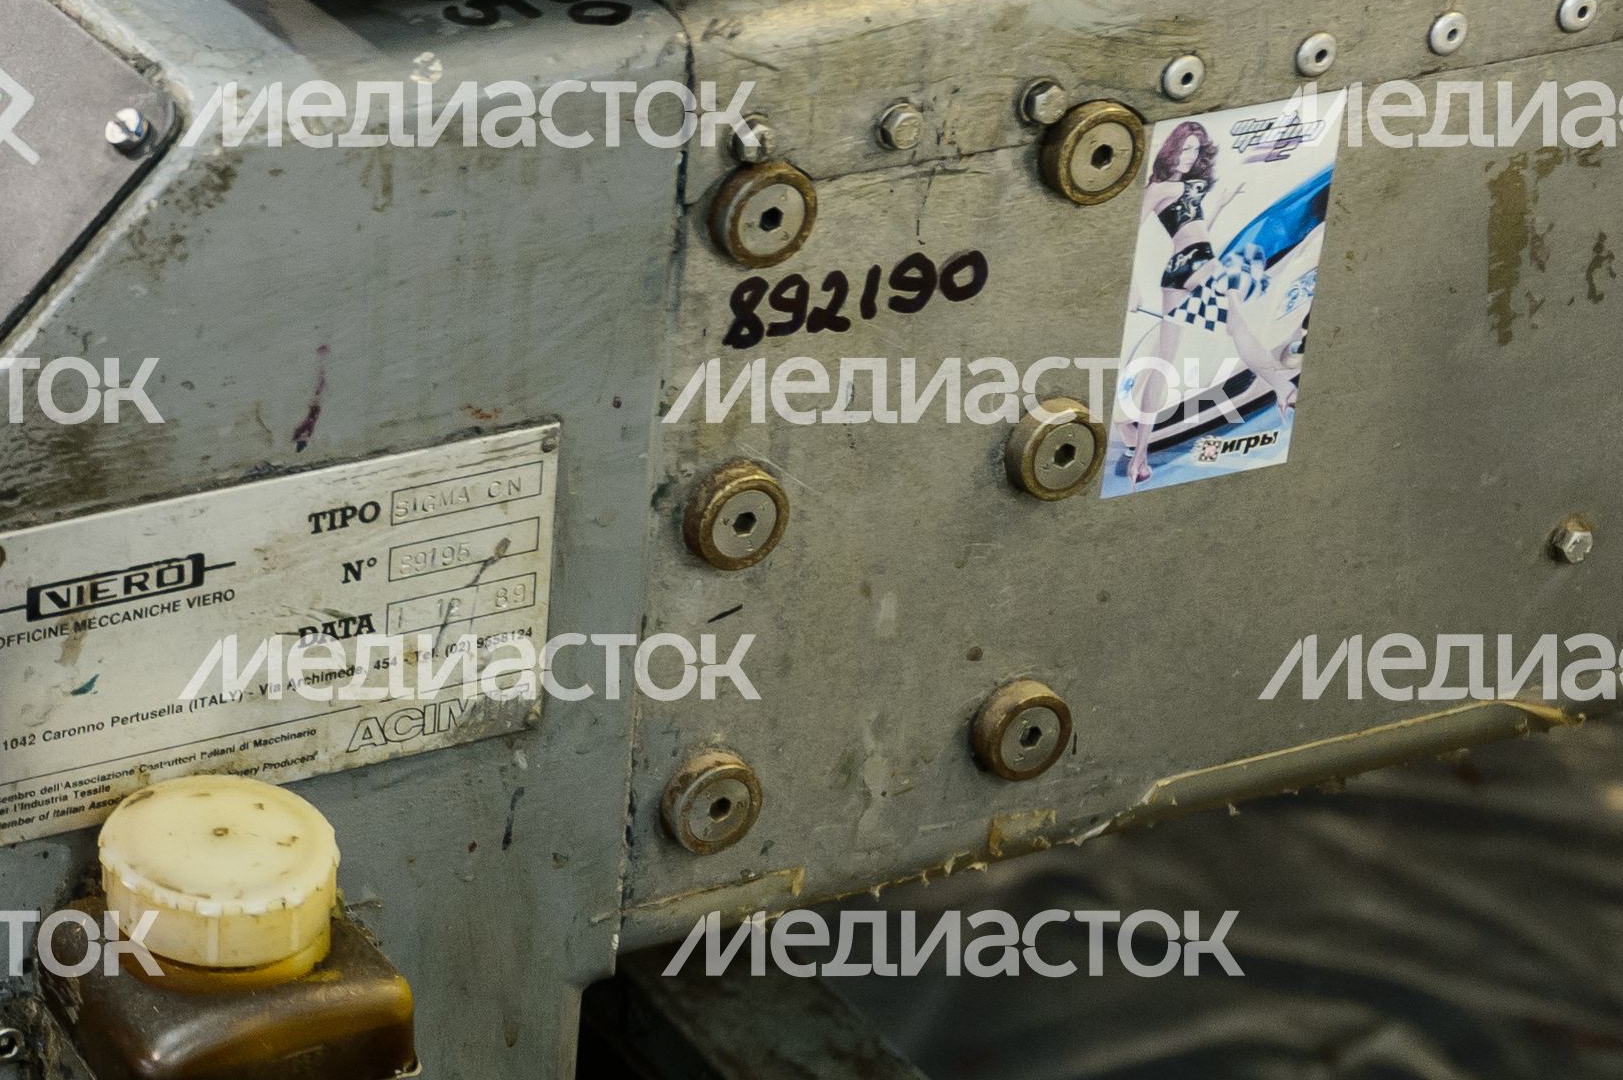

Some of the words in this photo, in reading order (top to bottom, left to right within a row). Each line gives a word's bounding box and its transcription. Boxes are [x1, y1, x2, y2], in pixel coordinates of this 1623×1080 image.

[722, 250, 989, 350] 892190
[1220, 431, 1279, 455] игры
[307, 501, 381, 534] TIPO
[394, 485, 471, 519] SIGMA
[44, 563, 186, 610] VIERO
[341, 557, 378, 584] N°
[73, 599, 181, 634] MECCANICHE
[186, 588, 236, 610] VIERO
[298, 613, 377, 649] DATA
[494, 583, 527, 609] 89
[42, 720, 105, 743] Caronno
[110, 703, 183, 728] Pertusella
[188, 688, 244, 714] (ITALY)
[259, 681, 281, 696] Via
[286, 662, 368, 693] Archimede,
[373, 656, 398, 671] 454
[414, 650, 439, 664] Tel.
[445, 639, 471, 659] (02)
[39, 767, 135, 796] dell'Associazione
[239, 741, 249, 752] di
[252, 727, 317, 749] Macchinario
[13, 794, 68, 813] l'Industria
[73, 784, 111, 799] Tessile
[38, 808, 50, 820] of
[52, 804, 86, 818] Italian
